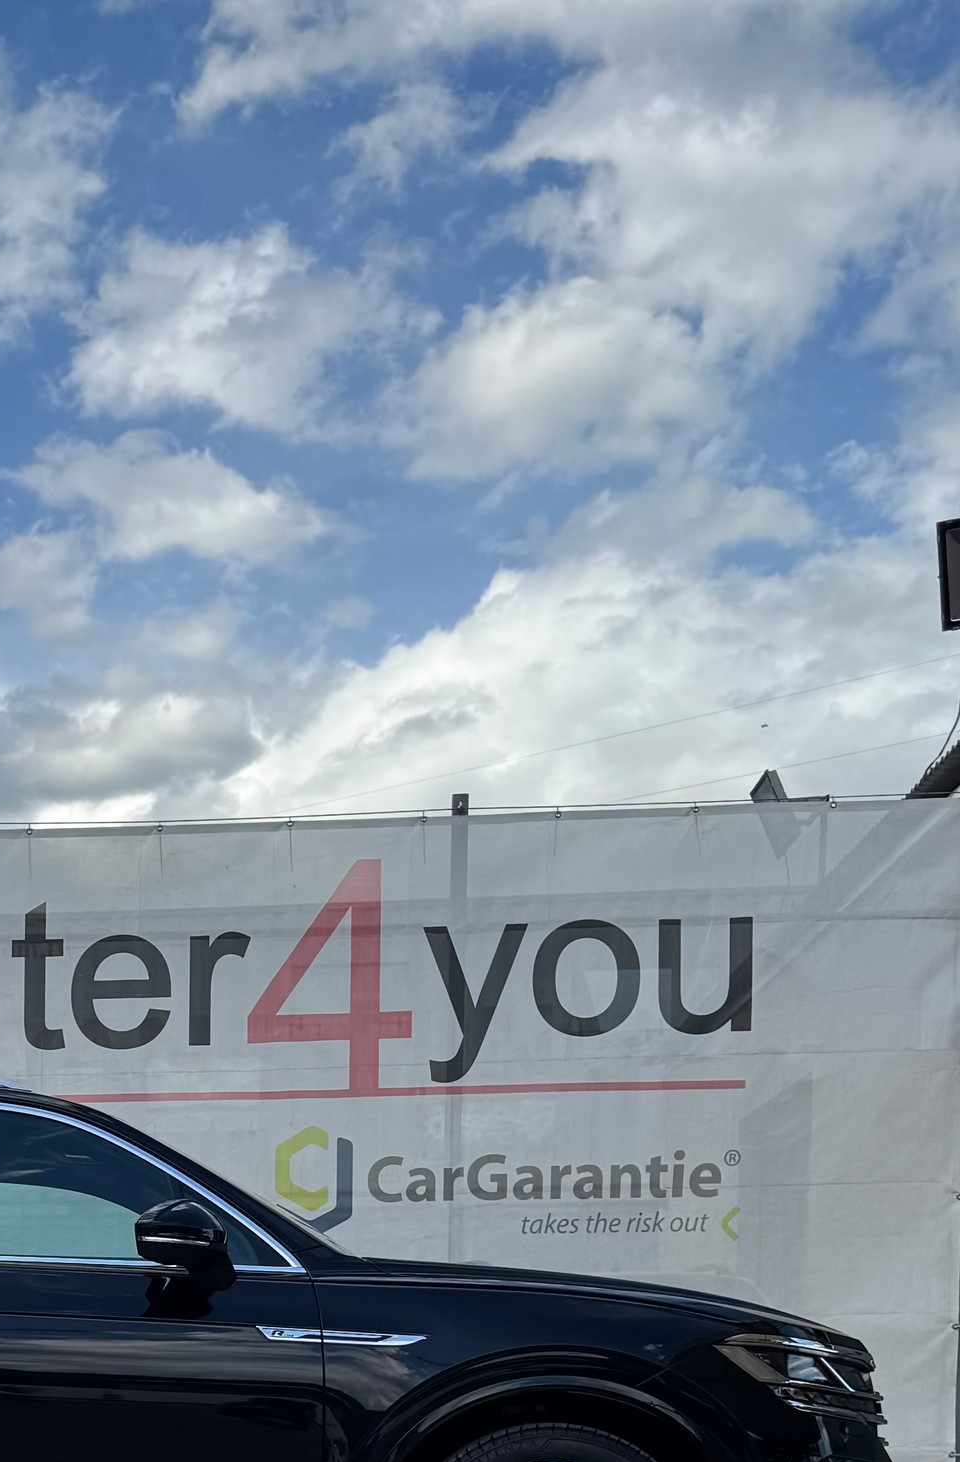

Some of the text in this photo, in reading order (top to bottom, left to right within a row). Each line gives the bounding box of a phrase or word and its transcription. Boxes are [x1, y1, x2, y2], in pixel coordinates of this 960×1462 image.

[521, 1211, 709, 1234] takes the risk out
